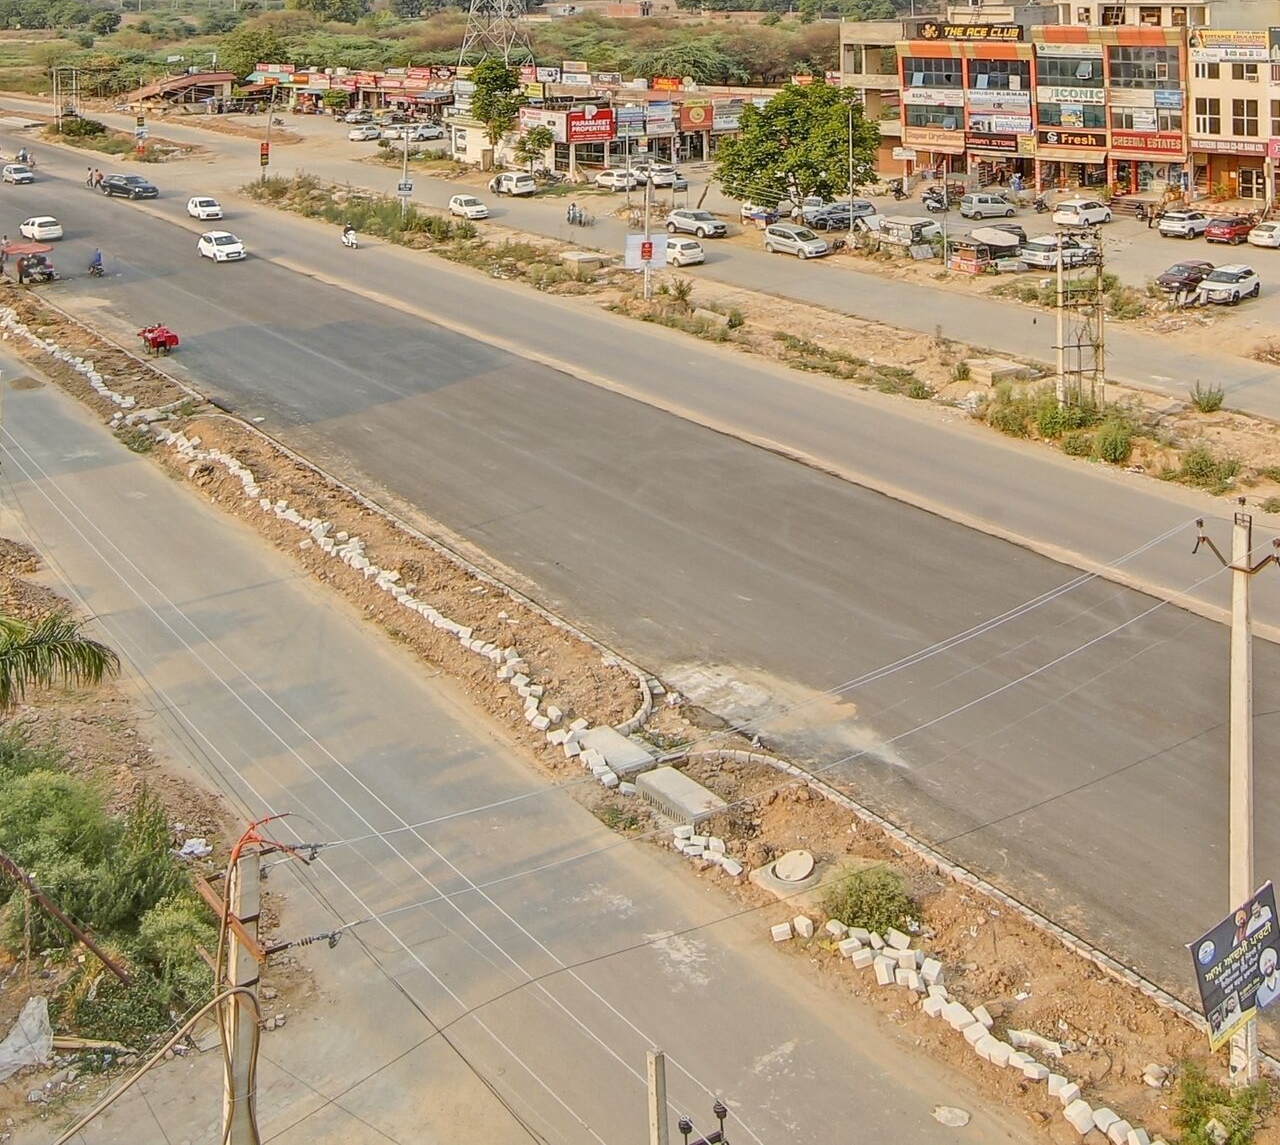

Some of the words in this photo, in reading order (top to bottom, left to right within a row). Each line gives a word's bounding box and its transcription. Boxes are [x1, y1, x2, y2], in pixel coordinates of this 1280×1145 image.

[944, 27, 964, 36] THE
[966, 27, 988, 36] ACE
[990, 28, 1019, 37] CLUB
[1054, 88, 1103, 100] ICONIC
[571, 118, 610, 127] PARAMJEET
[571, 124, 611, 133] PROPERTIES
[1060, 133, 1096, 146] Fresh
[1148, 137, 1182, 150] ESTATES
[1205, 962, 1223, 983] ਆਮ
[1223, 939, 1249, 967] ਆਦਮੀ
[1249, 921, 1272, 945] ਪਾਰਟੀ
